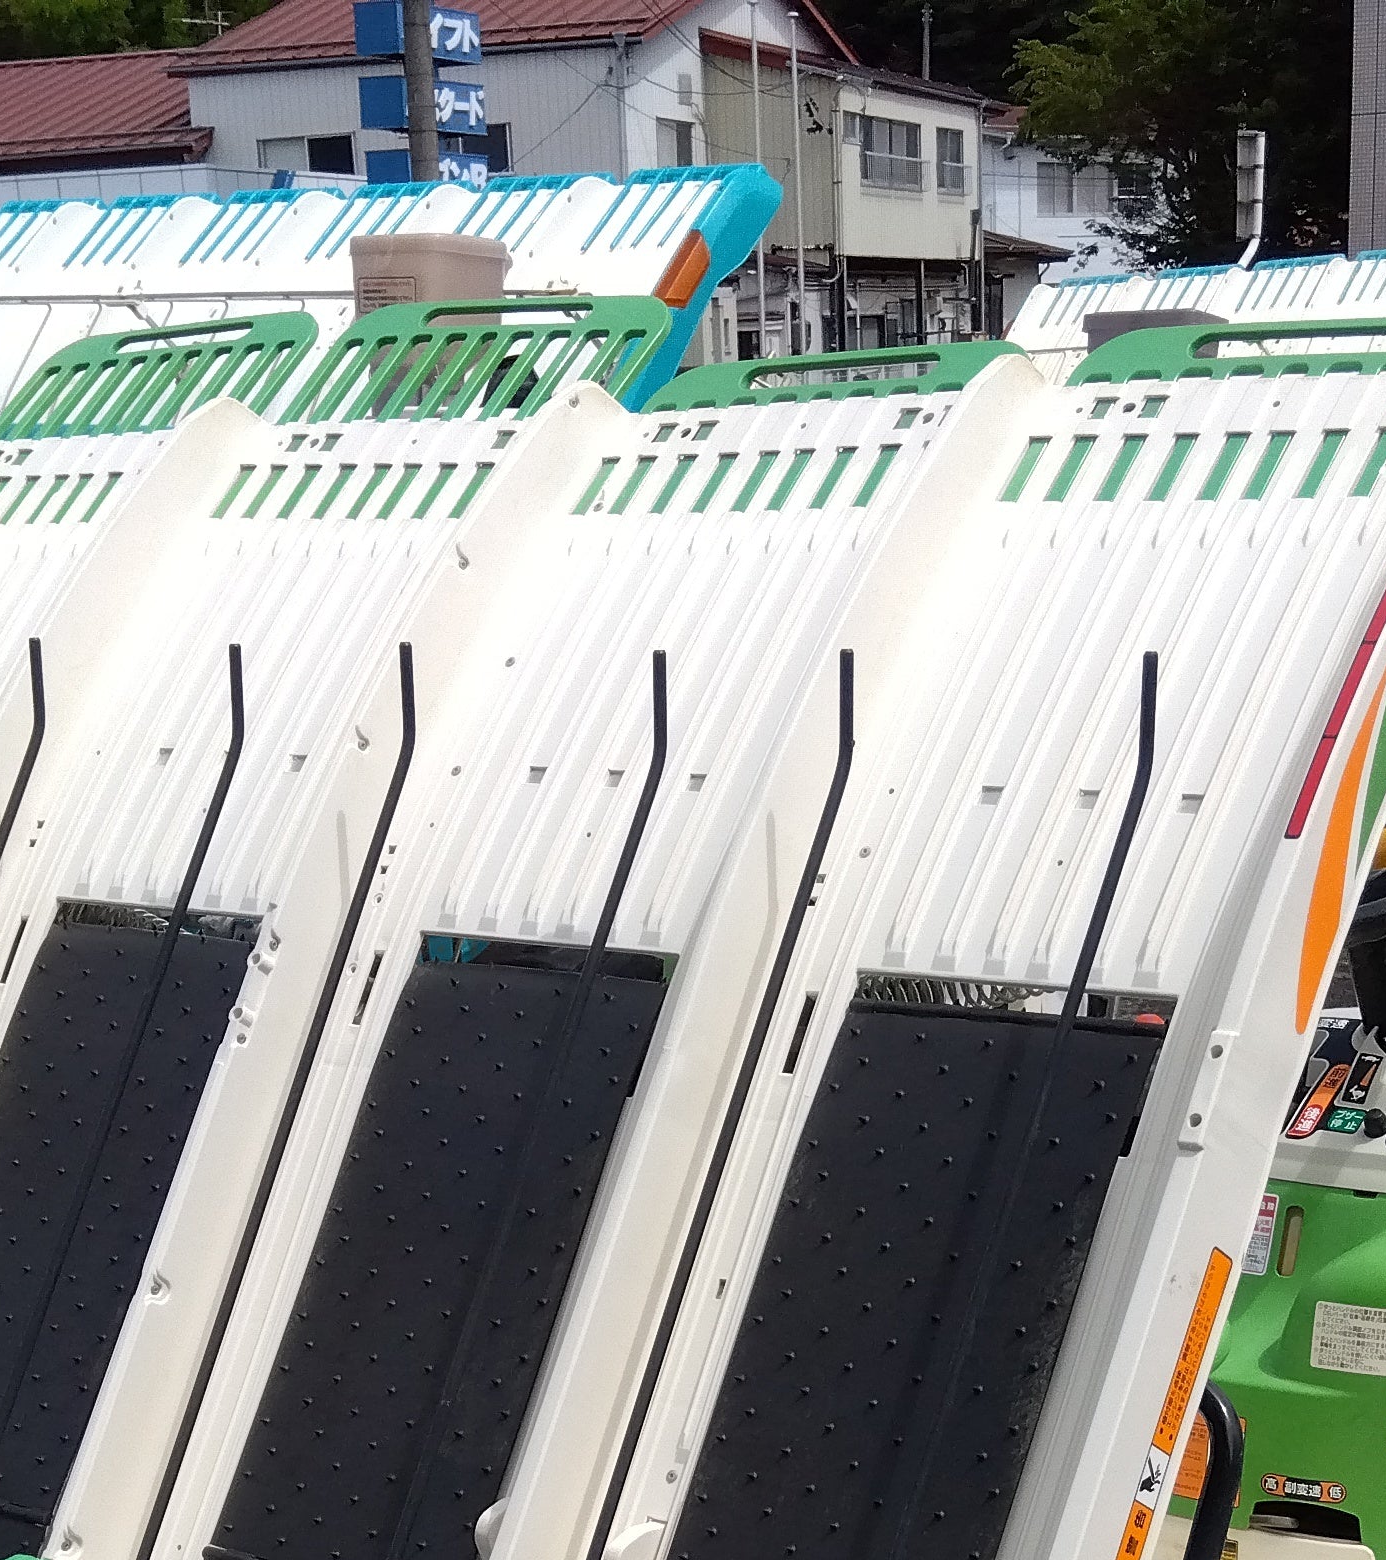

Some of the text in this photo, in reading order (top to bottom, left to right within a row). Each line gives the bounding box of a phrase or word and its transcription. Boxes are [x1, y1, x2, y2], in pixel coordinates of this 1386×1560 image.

[429, 13, 480, 53] イフト
[434, 87, 485, 126] クード
[1295, 1107, 1321, 1132] 後進
[1334, 1110, 1364, 1120] ブザー
[1330, 1119, 1358, 1130] 停止
[1265, 1477, 1278, 1490] 高
[1284, 1480, 1322, 1498] 副変速
[1328, 1486, 1343, 1499] 低
